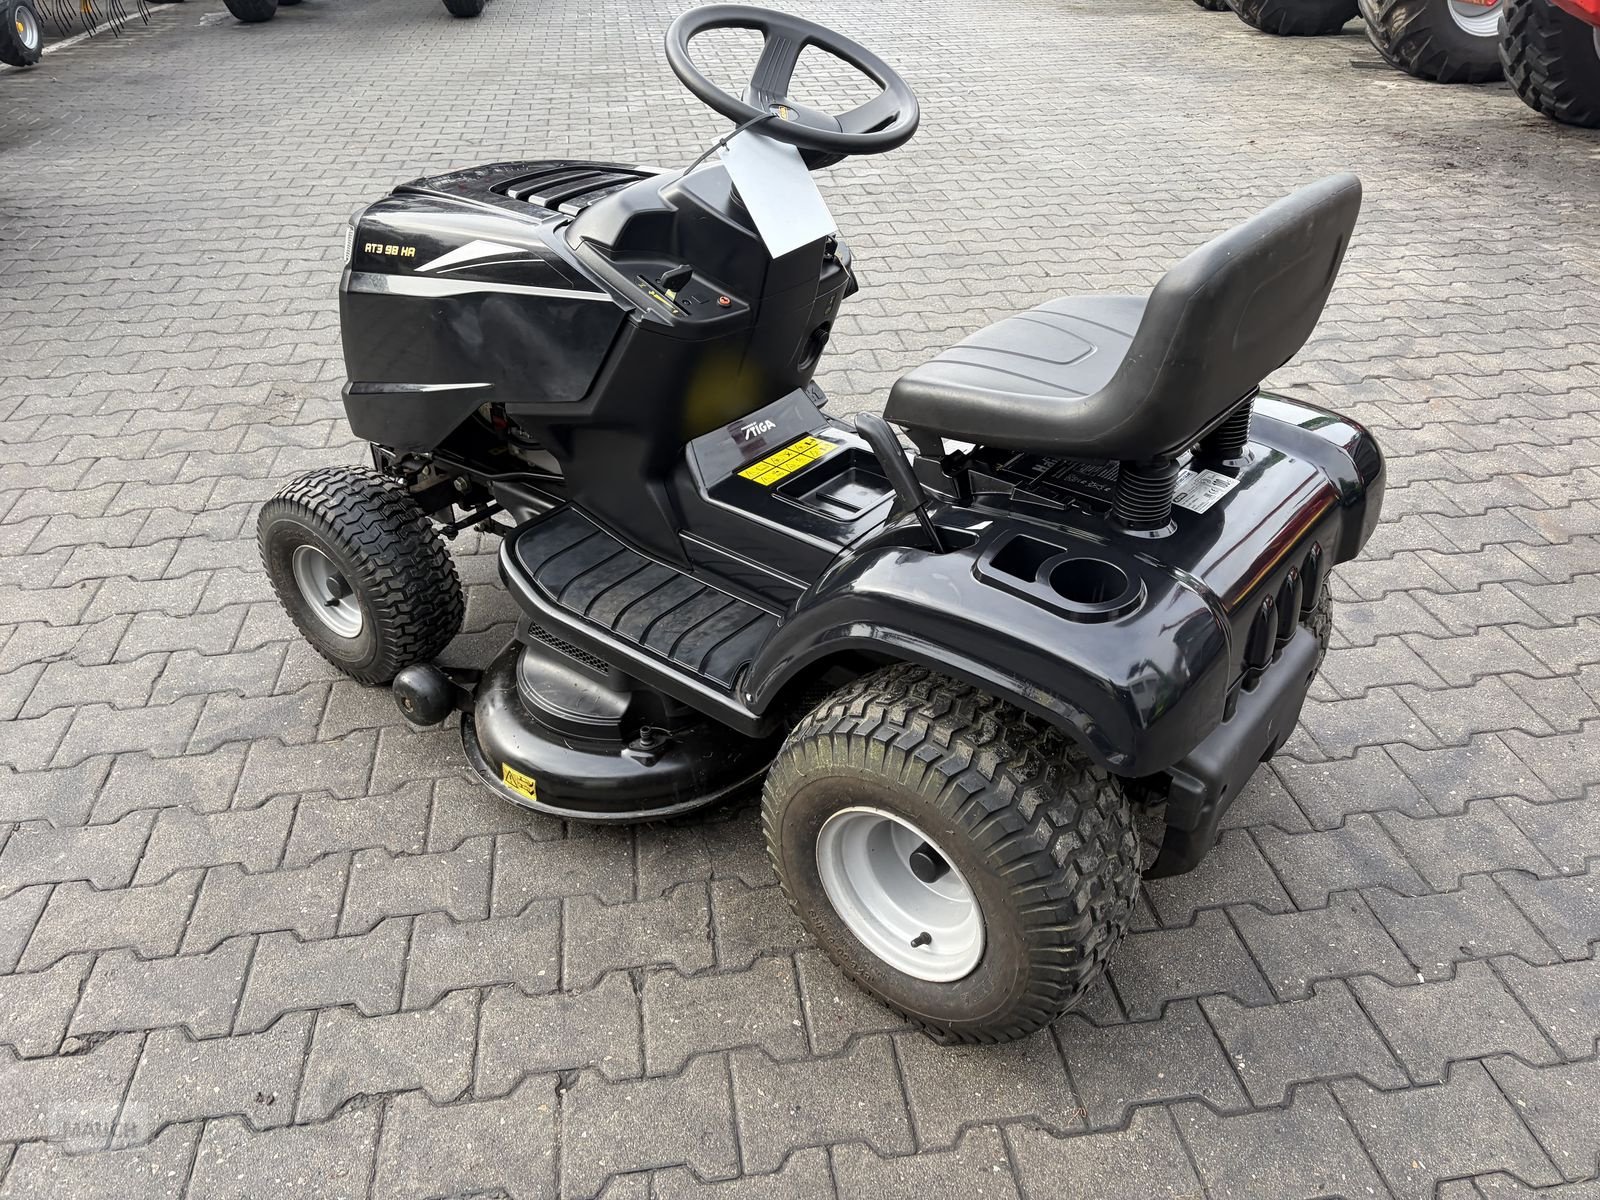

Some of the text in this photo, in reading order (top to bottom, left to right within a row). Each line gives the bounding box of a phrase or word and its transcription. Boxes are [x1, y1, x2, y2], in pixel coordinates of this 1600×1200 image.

[364, 243, 416, 257] AT3 98 HA
[741, 419, 777, 441] STIGA
